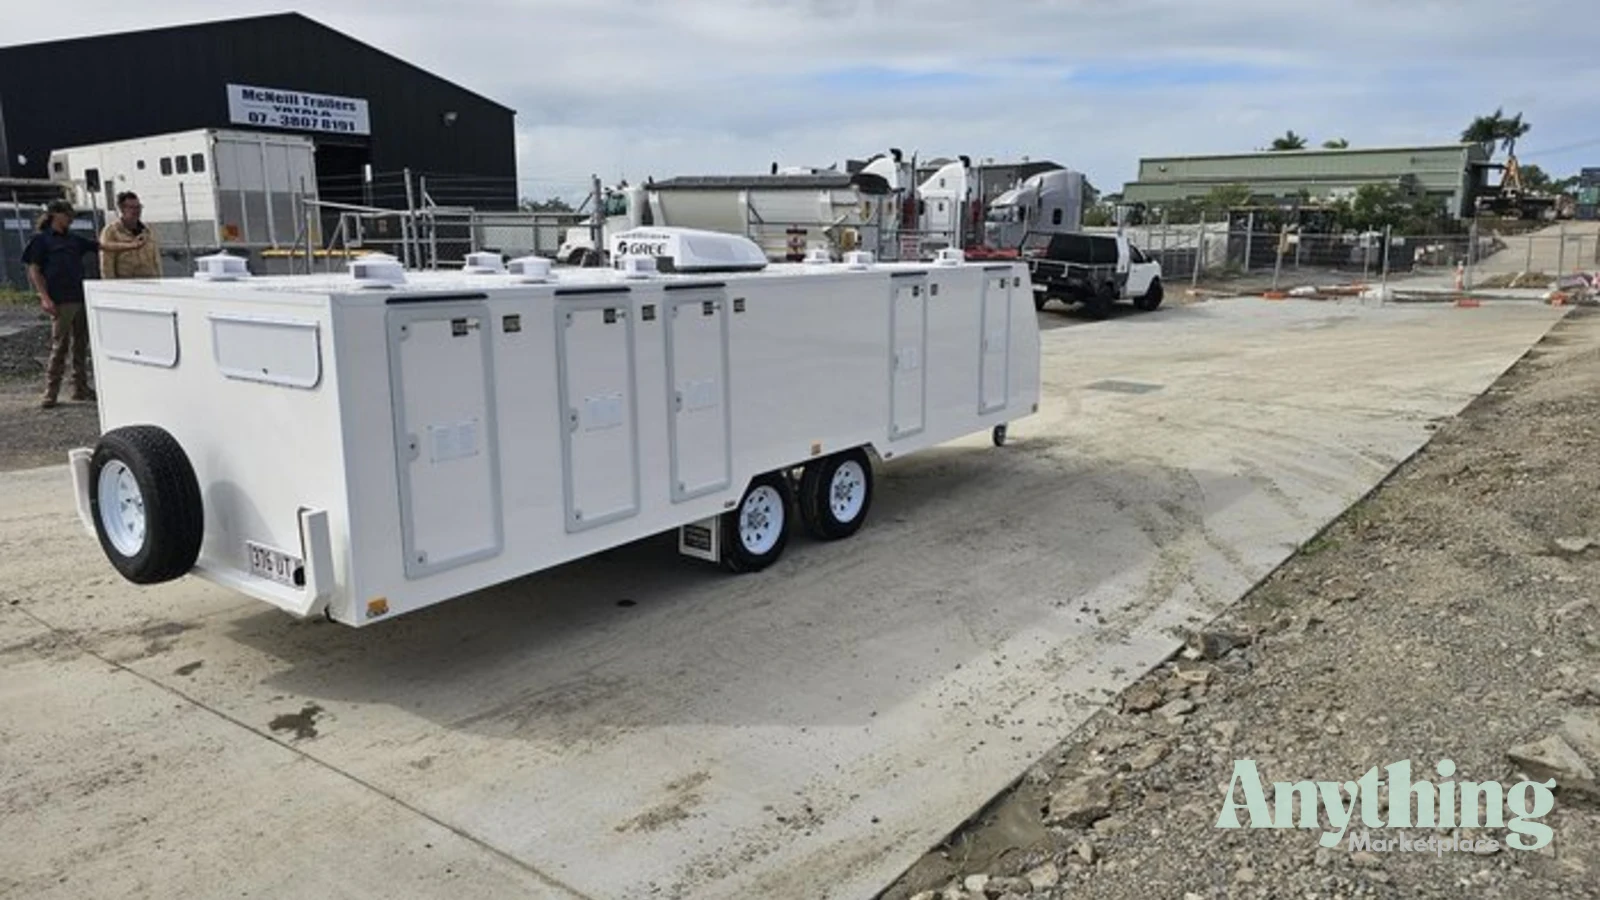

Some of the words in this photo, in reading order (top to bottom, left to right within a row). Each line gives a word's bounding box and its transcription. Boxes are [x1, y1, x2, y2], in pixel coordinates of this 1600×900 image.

[242, 89, 299, 105] McNeill
[302, 95, 357, 111] Trailers
[248, 112, 267, 123] 07
[280, 115, 318, 129] 3807
[321, 117, 355, 131] 8191
[630, 242, 668, 255] GREE
